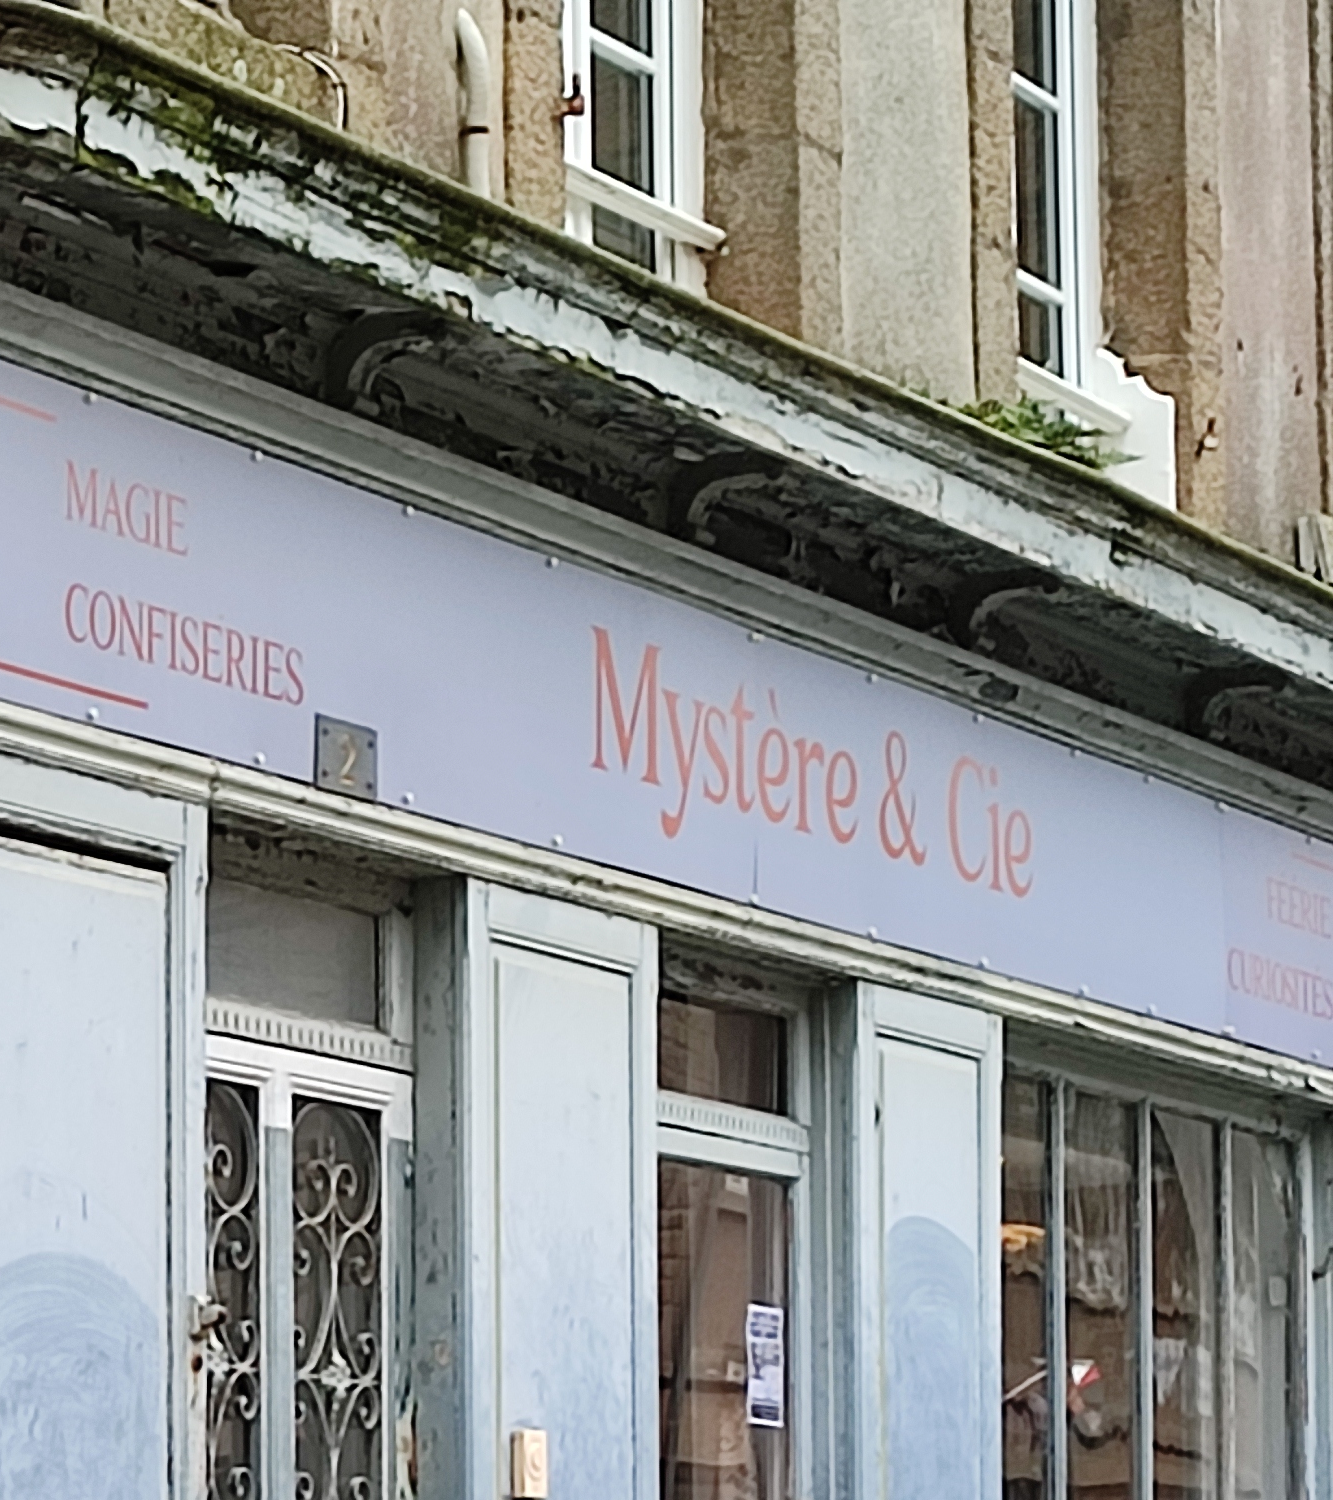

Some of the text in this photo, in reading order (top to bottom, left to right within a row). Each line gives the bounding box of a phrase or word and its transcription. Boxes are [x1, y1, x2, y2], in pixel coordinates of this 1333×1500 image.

[66, 460, 189, 556] MAGIE
[64, 583, 304, 705] CONFISERIES
[338, 733, 357, 787] 2
[590, 625, 1033, 898] Mystère & Cie
